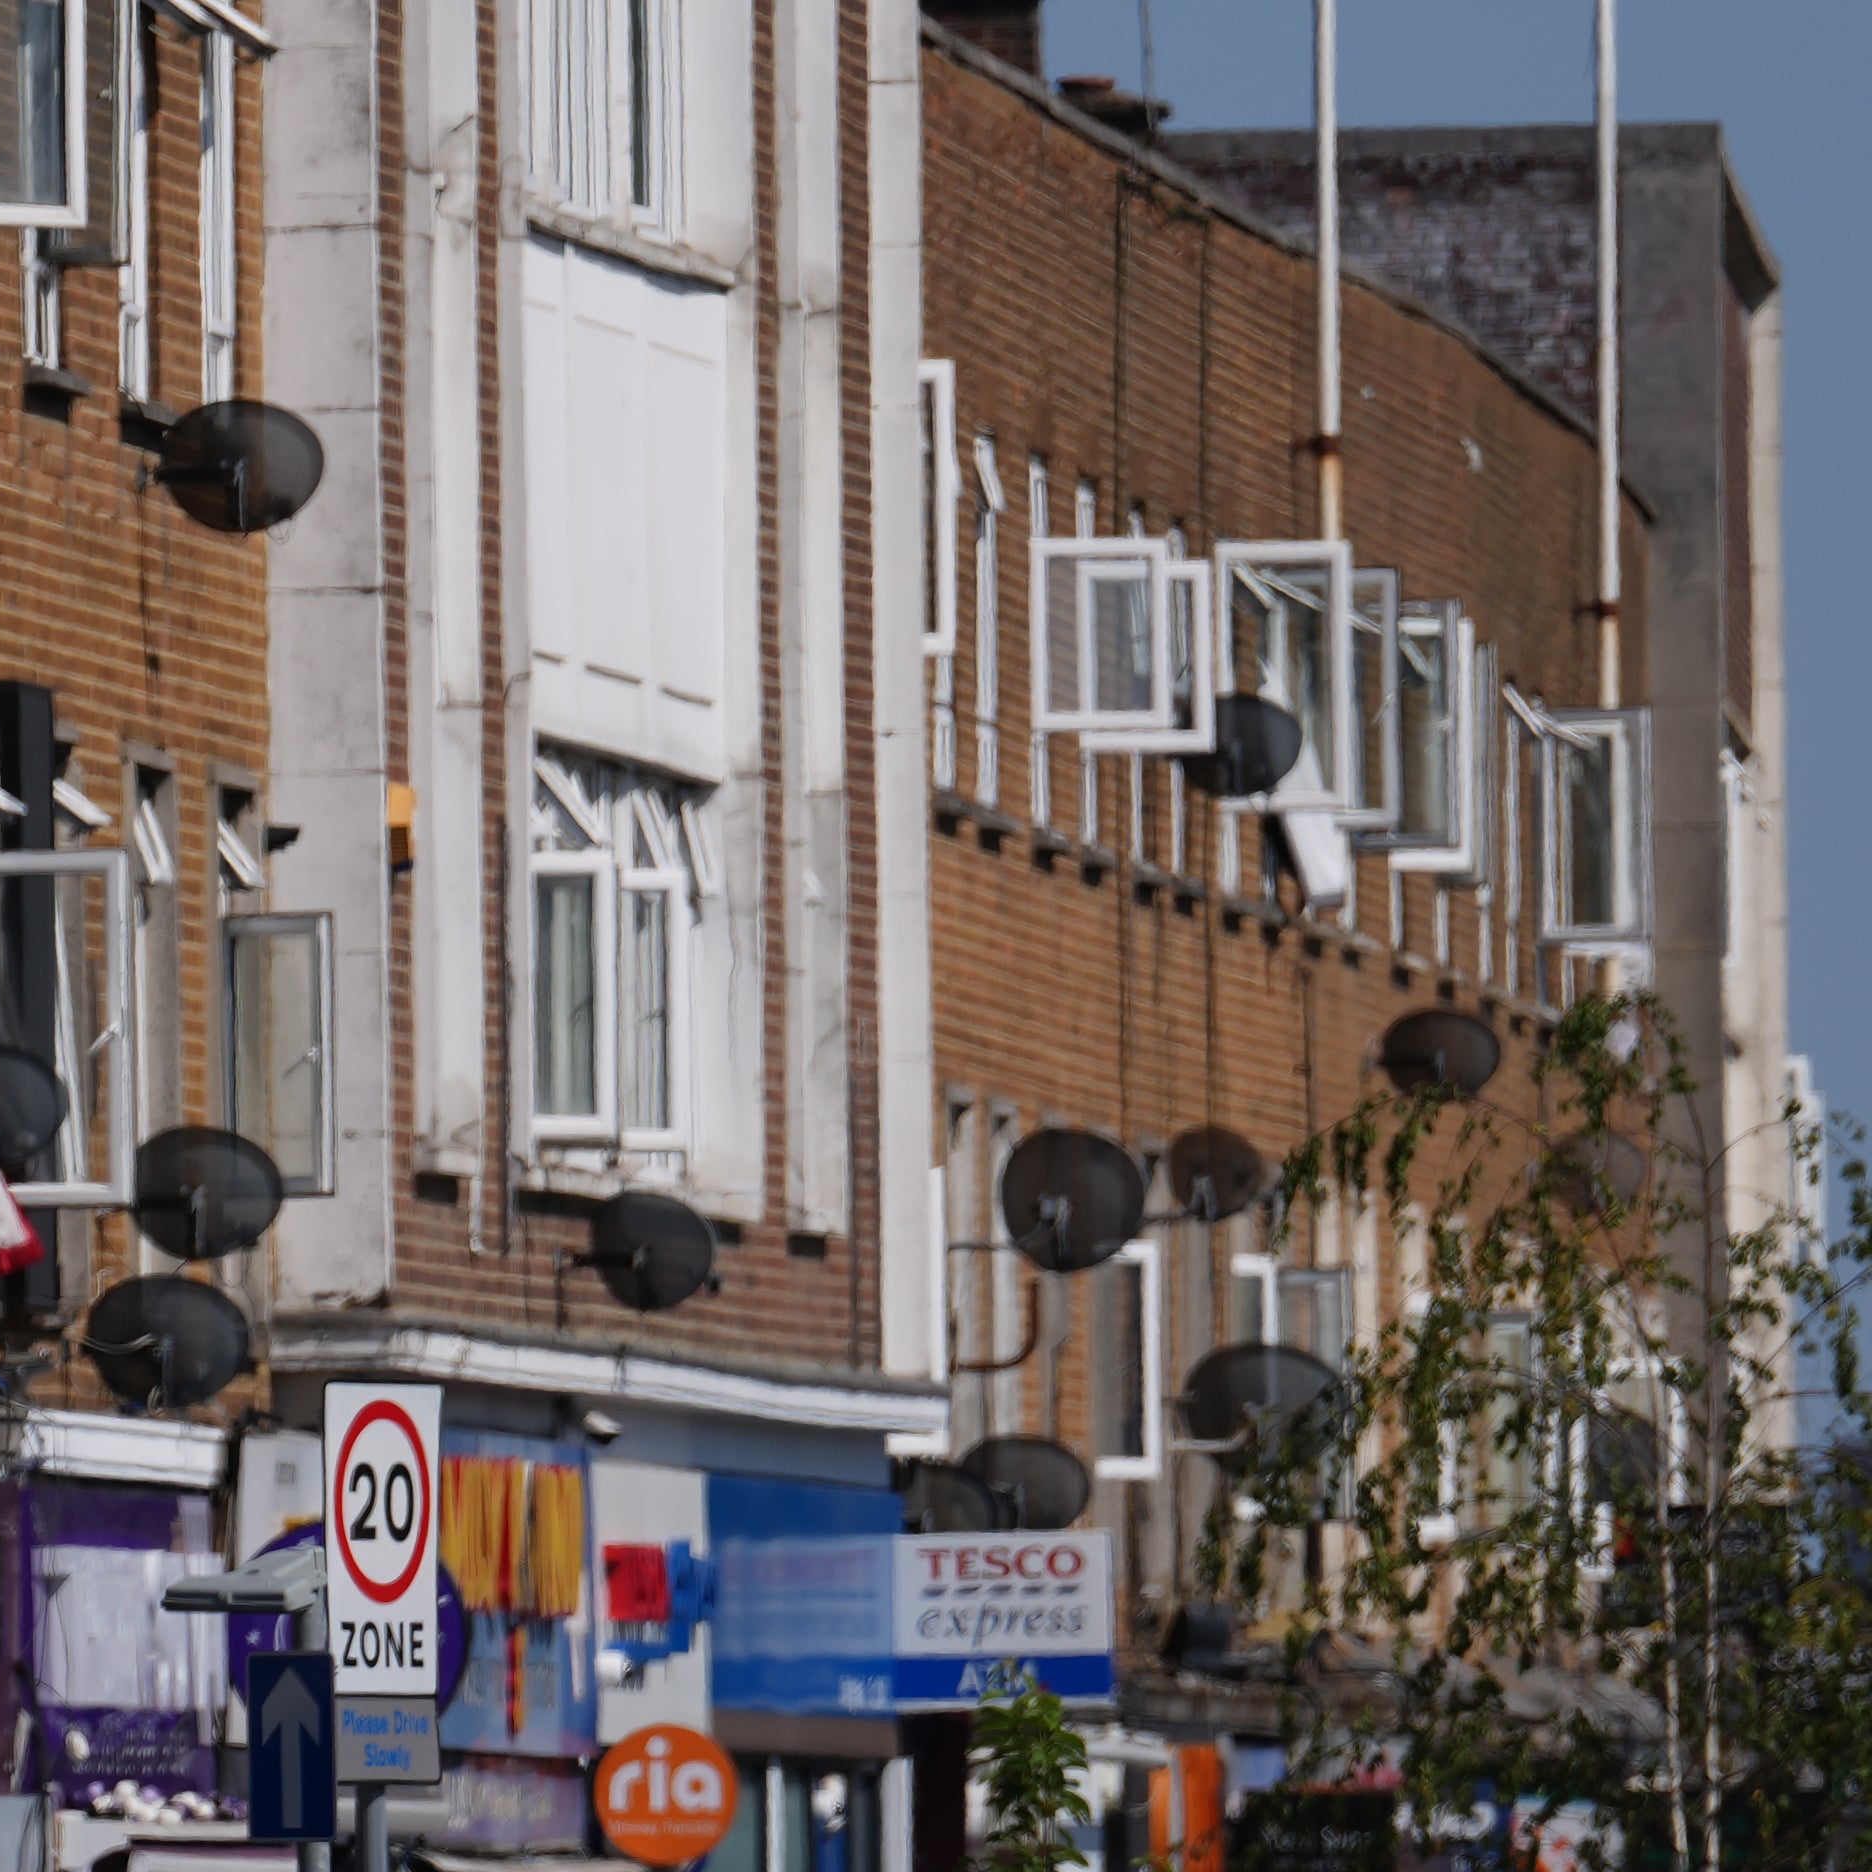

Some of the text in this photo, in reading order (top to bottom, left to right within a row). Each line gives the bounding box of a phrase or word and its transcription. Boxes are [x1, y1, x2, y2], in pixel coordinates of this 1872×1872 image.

[350, 1463, 415, 1542] 20
[918, 1545, 1088, 1580] TESCO
[340, 1621, 425, 1668] ZONE
[918, 1601, 1088, 1646] express
[342, 1710, 428, 1735] Please Drive
[364, 1743, 411, 1772] Slowly
[609, 1735, 723, 1813] ria
